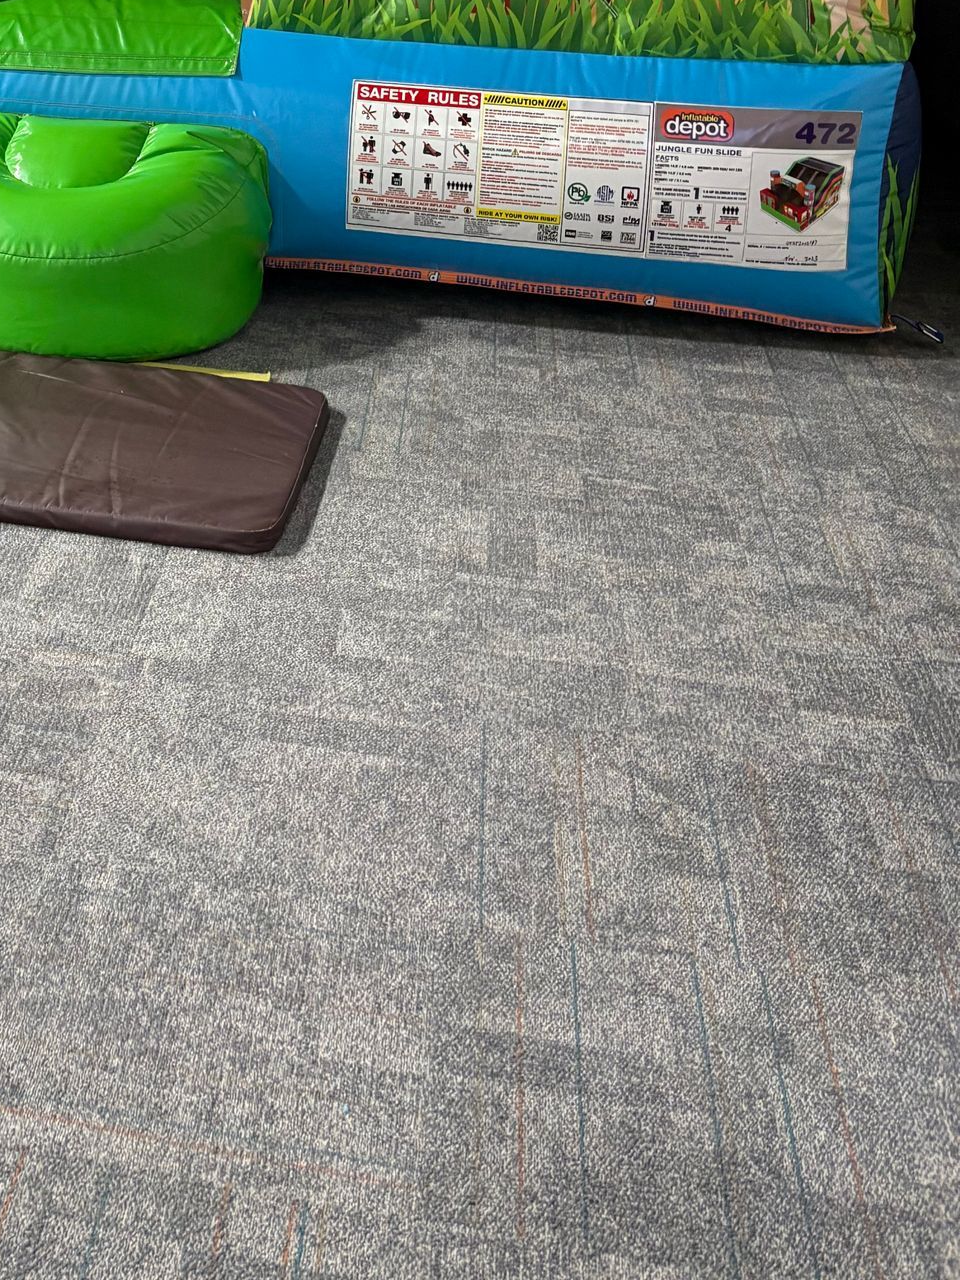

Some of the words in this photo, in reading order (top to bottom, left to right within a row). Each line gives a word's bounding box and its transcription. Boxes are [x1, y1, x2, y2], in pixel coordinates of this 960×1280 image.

[359, 86, 419, 102] SAFETY
[428, 93, 479, 107] RULES
[504, 96, 545, 107] CAUTION
[681, 112, 719, 122] Inflatable
[665, 116, 728, 140] depot
[795, 121, 857, 145] 472
[655, 145, 692, 154] JUNGLE
[695, 147, 713, 155] FUN
[715, 148, 742, 157] SLIDE
[571, 186, 585, 197] Pb
[725, 224, 732, 233] 4
